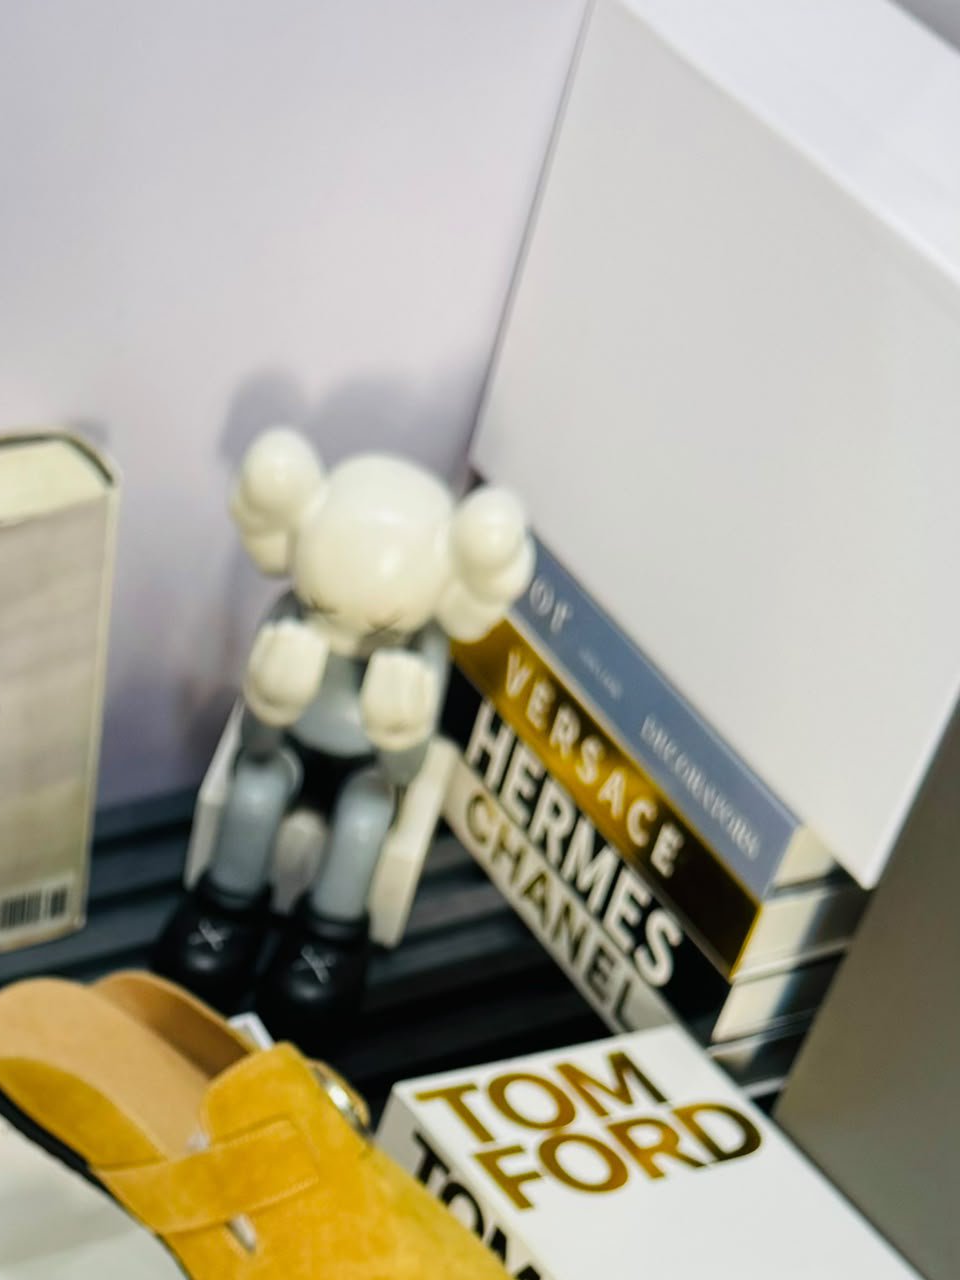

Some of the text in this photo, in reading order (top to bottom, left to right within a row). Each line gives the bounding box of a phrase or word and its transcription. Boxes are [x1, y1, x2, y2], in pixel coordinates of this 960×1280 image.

[464, 700, 683, 988] HERMES
[504, 649, 685, 878] VERSACE
[465, 794, 640, 1036] CHANEL
[414, 1050, 671, 1145] TOM
[473, 1102, 762, 1211] FORD
